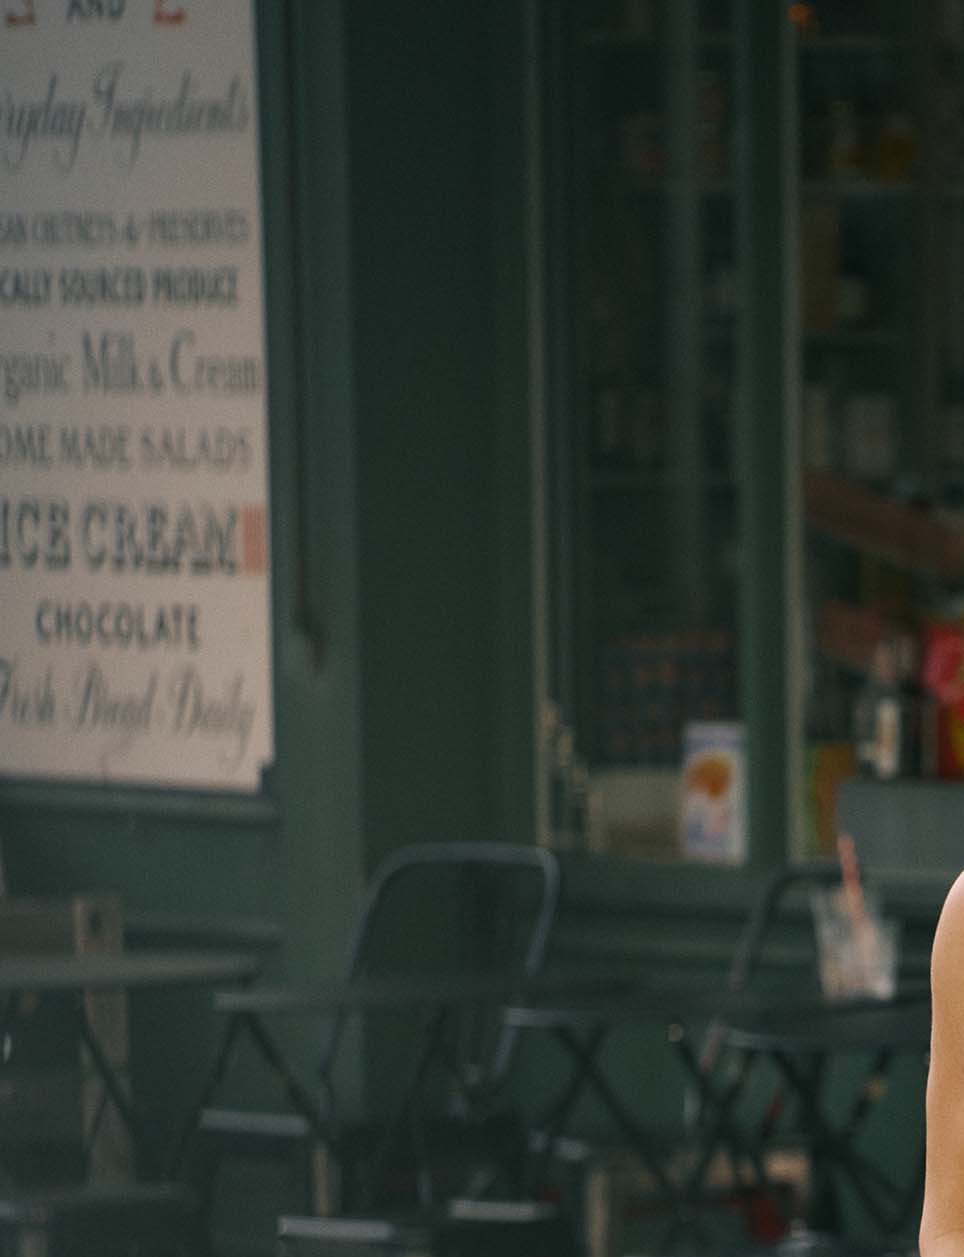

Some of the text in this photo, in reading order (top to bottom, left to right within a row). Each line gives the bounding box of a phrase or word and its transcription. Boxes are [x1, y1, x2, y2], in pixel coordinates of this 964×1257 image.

[0, 72, 87, 174] ryday
[0, 330, 70, 406] ganic
[59, 423, 132, 473] MADE
[138, 424, 253, 474] SALADS
[0, 498, 239, 578] ICE CREAM
[36, 599, 201, 650] CHOCOLATE
